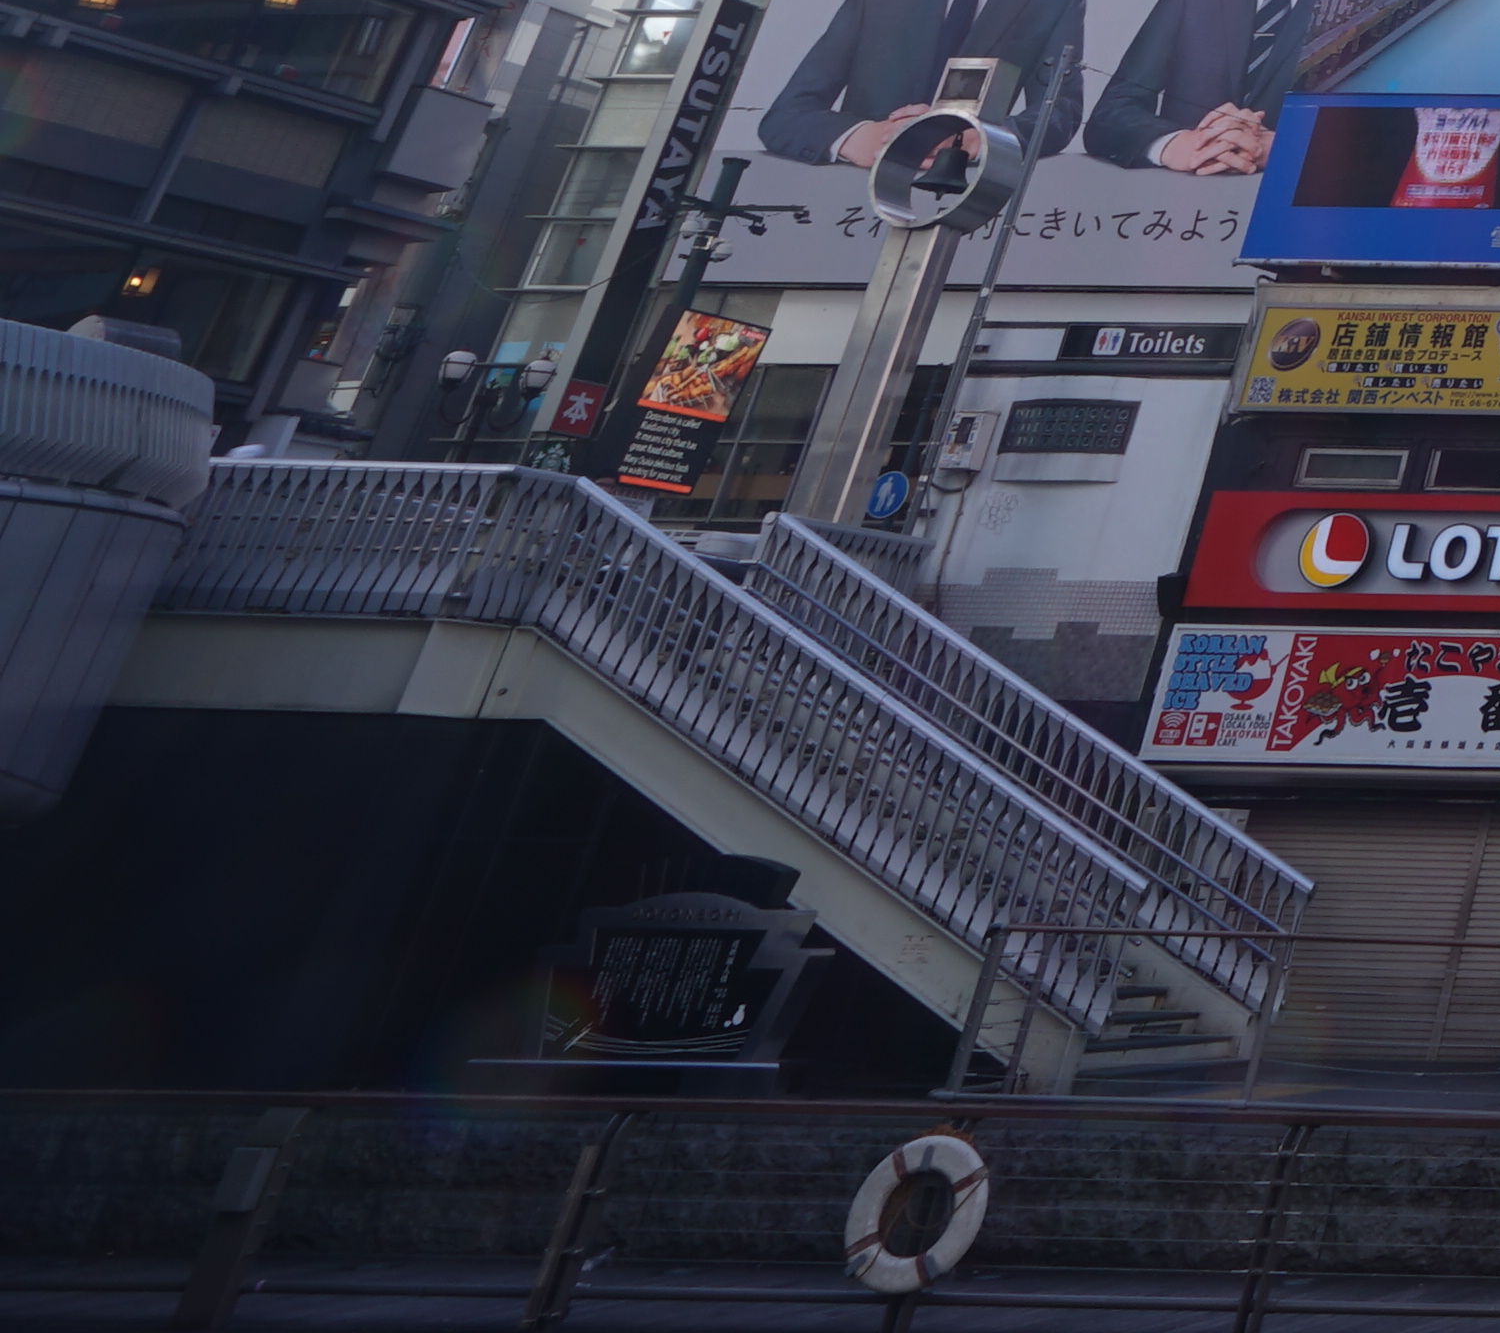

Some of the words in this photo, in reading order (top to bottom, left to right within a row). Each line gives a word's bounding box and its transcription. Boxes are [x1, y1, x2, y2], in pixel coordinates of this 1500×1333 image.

[634, 22, 745, 233] TSUTAYA
[1337, 312, 1375, 322] KANSAI
[1378, 313, 1415, 322] INVEST
[1417, 313, 1492, 323] CORPORATION
[1129, 332, 1206, 356] Toilets
[1331, 322, 1489, 349] 店舗情報館
[1277, 389, 1340, 404] 株式会社
[1347, 389, 1444, 406] 関西インベスト
[1177, 635, 1267, 654] KOREAN
[1172, 653, 1238, 673] STYLE
[1167, 673, 1254, 693] SHAVED
[1271, 636, 1319, 749] TAKOYAKI
[1161, 691, 1200, 710] ICE
